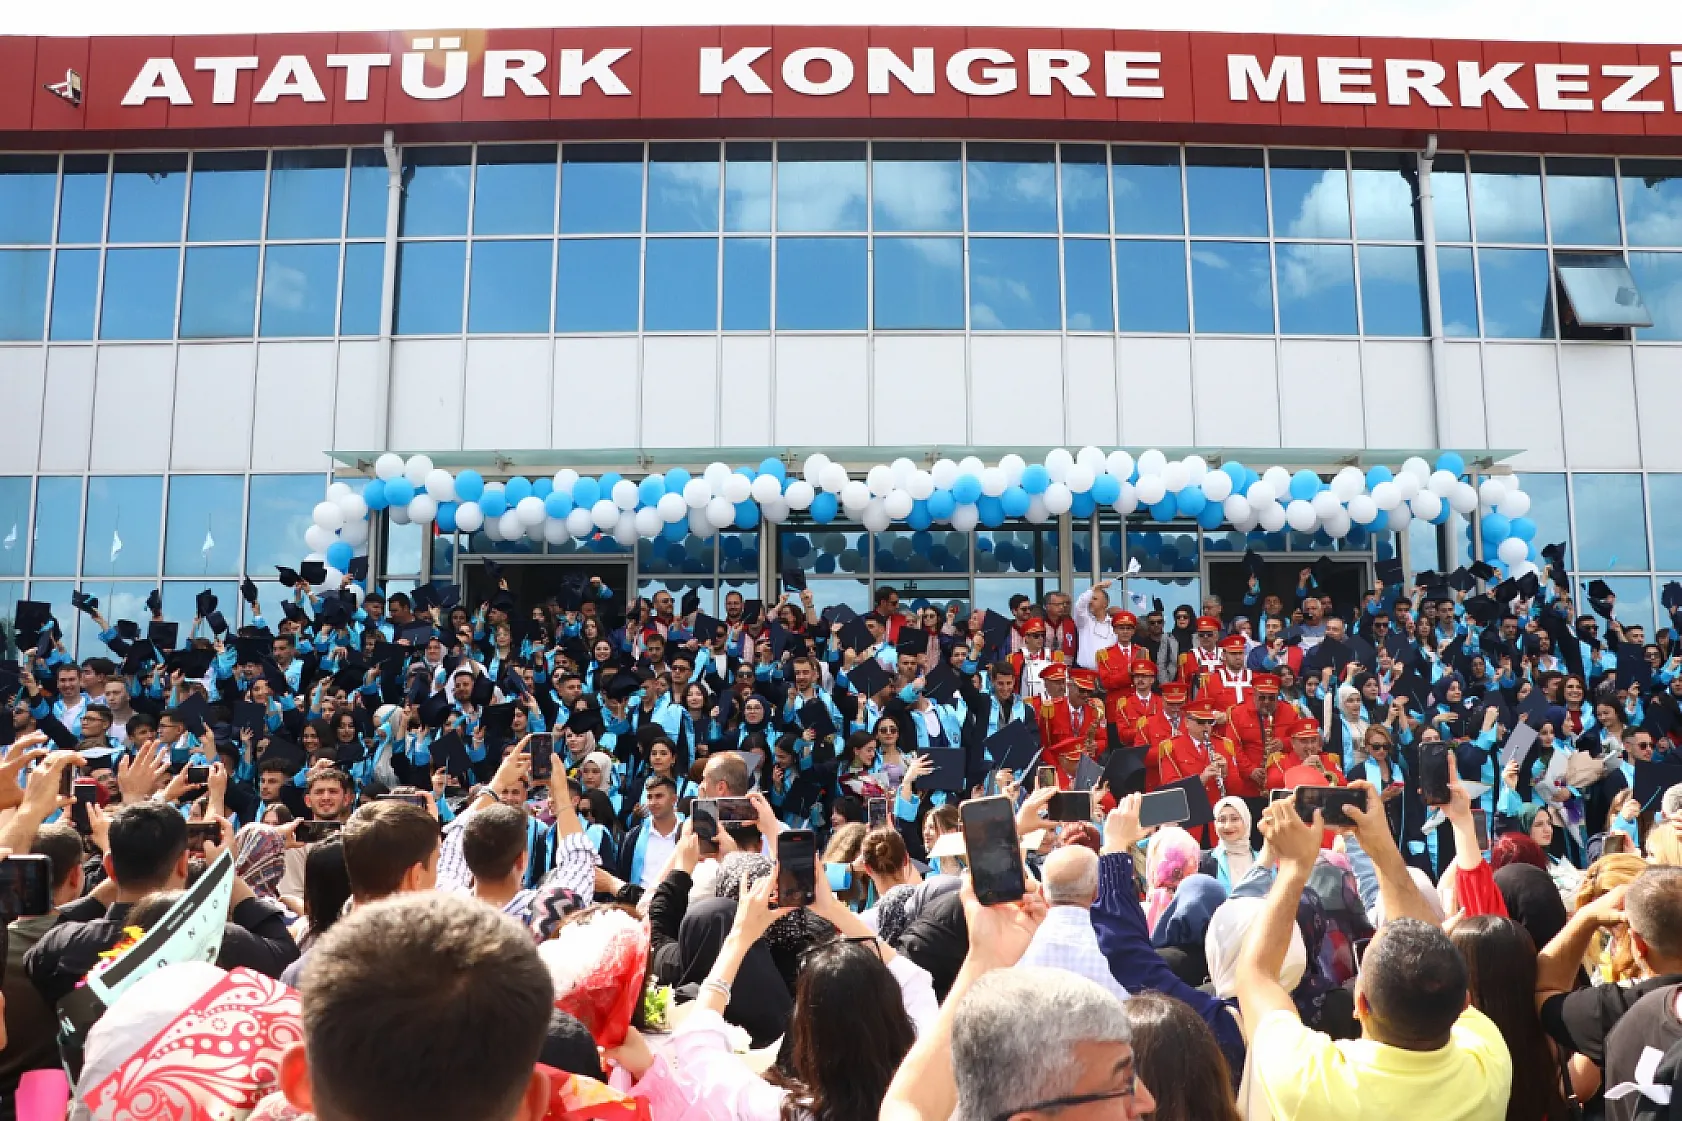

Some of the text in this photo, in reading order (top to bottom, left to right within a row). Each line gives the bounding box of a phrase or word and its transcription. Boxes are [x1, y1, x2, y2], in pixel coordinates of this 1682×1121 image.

[120, 36, 1682, 112] ATATÜRK KONGRE MERKEZİ
